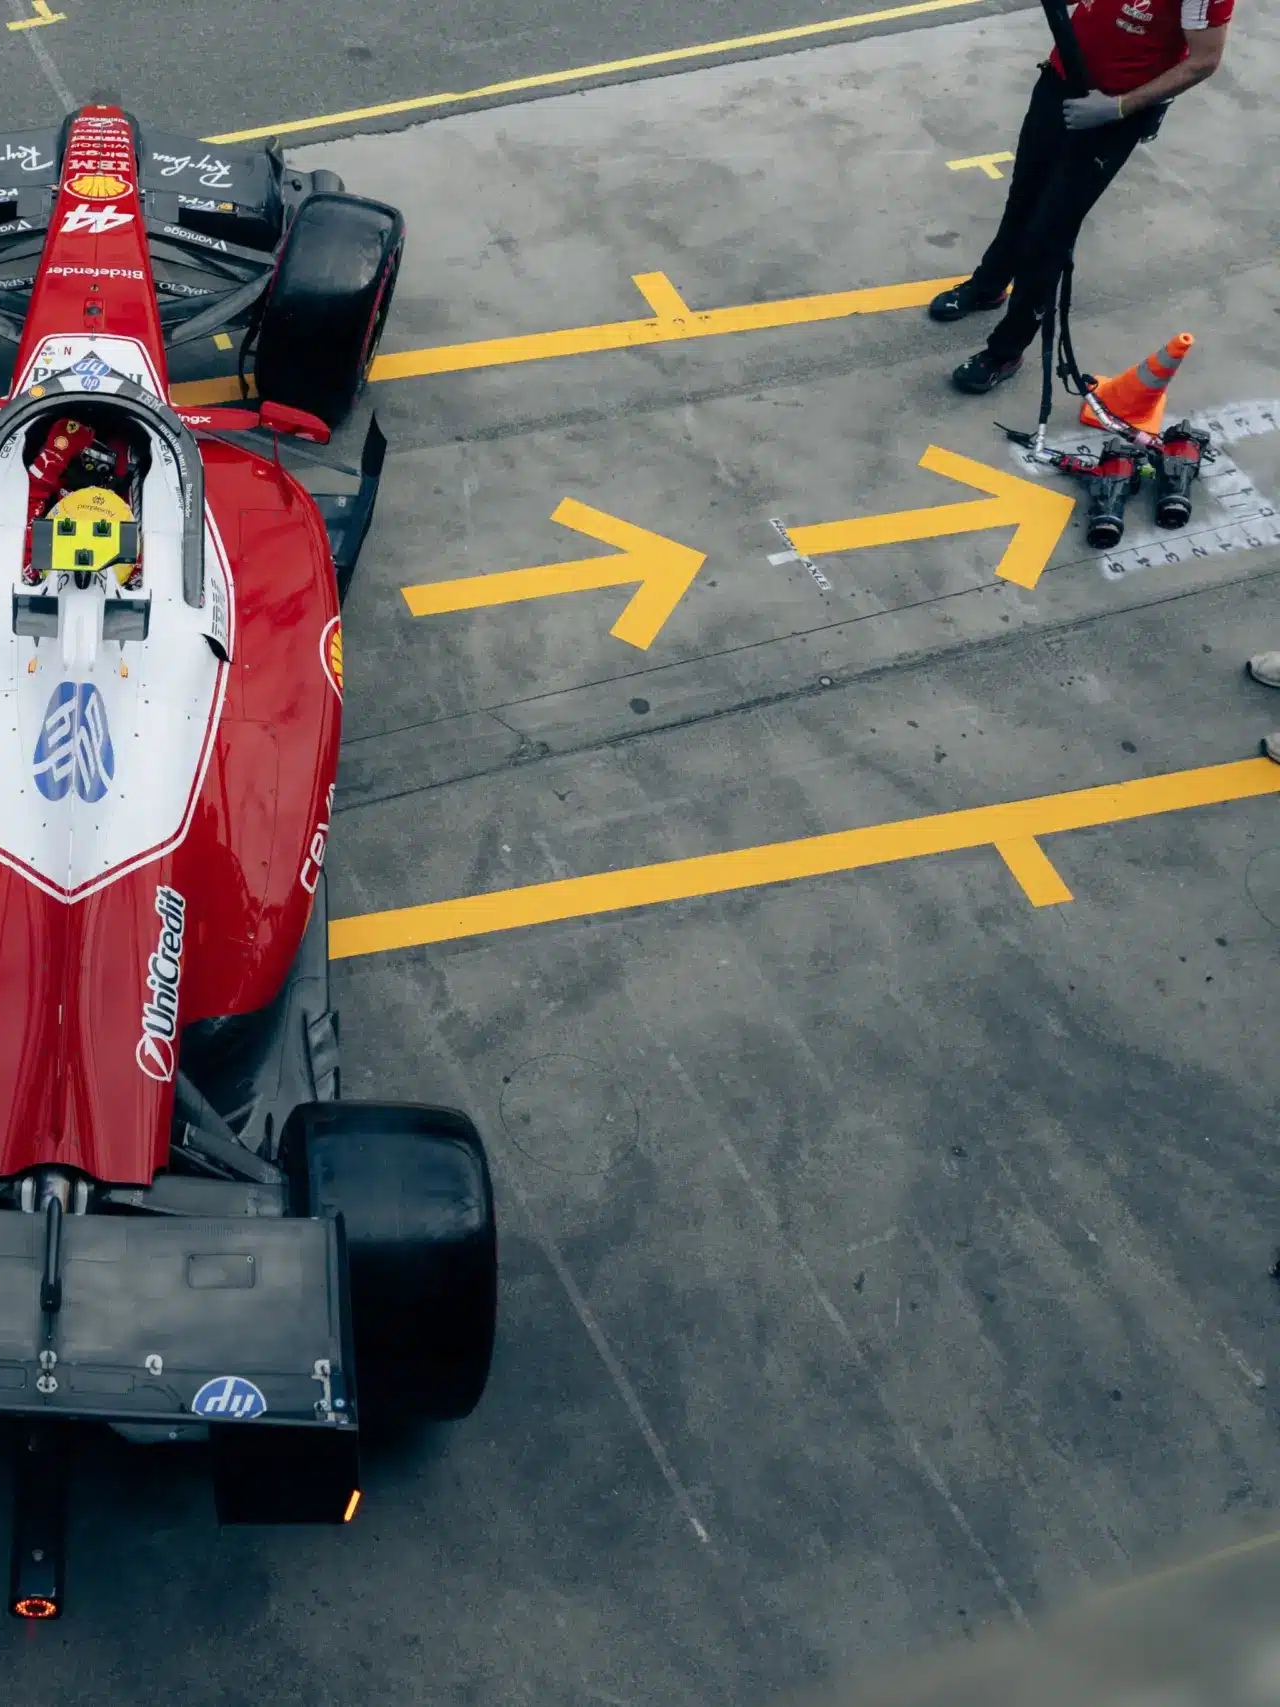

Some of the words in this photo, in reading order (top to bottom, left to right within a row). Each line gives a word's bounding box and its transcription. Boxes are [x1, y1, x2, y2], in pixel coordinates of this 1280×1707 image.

[68, 159, 131, 172] IBM
[152, 152, 233, 188] Ray-Ban
[60, 203, 135, 234] 44
[163, 225, 213, 246] vantage
[46, 265, 145, 281] Bitdefender
[136, 390, 166, 412] IBM
[76, 503, 117, 518] perplexity
[185, 483, 193, 518] Bitdefender
[1165, 552, 1181, 563] 3
[1192, 547, 1208, 558] 2
[803, 560, 830, 589] AXLE
[142, 884, 187, 1038] UniCredit
[204, 1377, 256, 1418] hp
